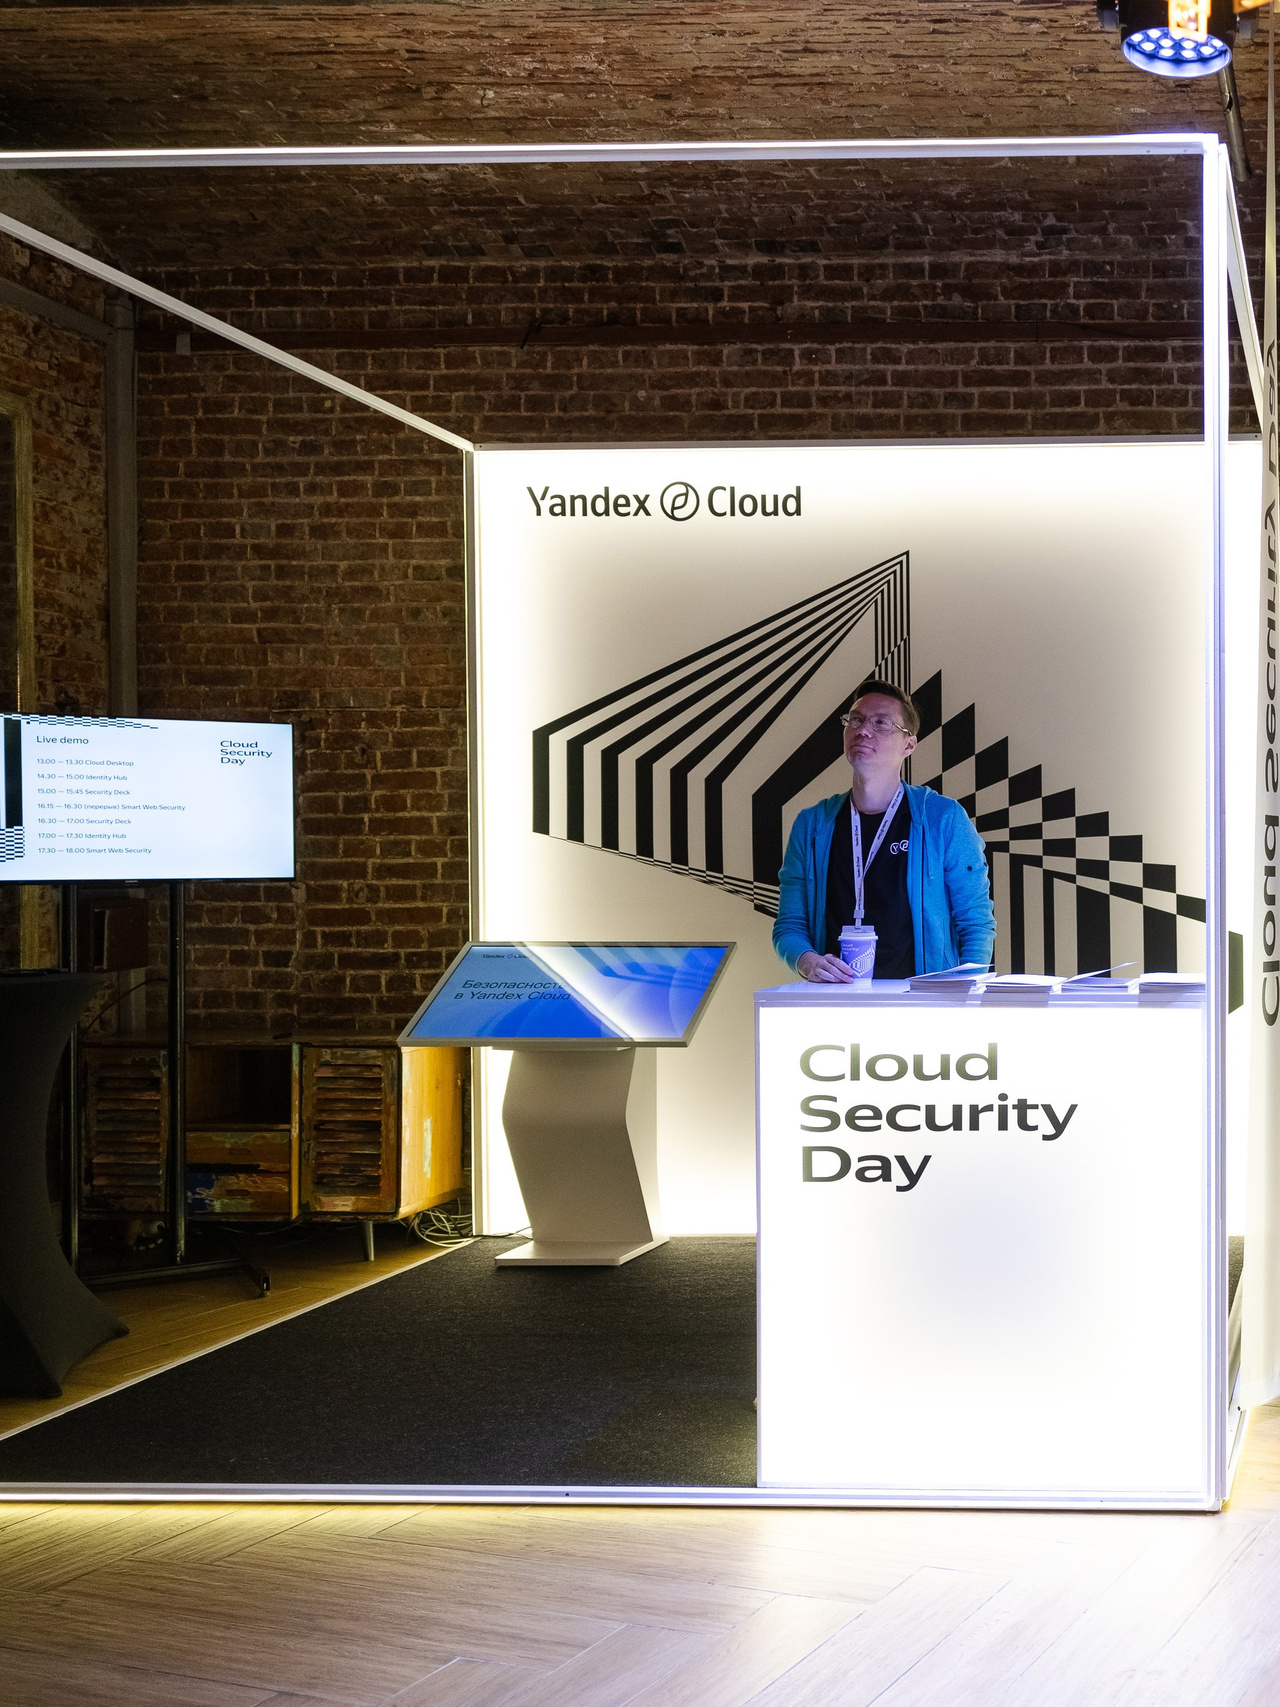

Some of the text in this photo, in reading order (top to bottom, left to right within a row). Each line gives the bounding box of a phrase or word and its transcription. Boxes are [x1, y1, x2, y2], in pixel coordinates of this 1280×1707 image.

[526, 485, 802, 517] Yandex Cloud
[36, 735, 89, 745] Live demo
[220, 740, 258, 748] Cloud
[220, 749, 273, 758] Security
[220, 757, 246, 766] Day
[120, 803, 141, 811] Smart
[158, 804, 186, 812] Security
[124, 847, 152, 855] Security
[462, 980, 567, 989] Безопасность
[454, 991, 572, 1000] в Yandex Cloud
[800, 1043, 998, 1081] Cloud
[800, 1093, 1079, 1141] Security
[802, 1146, 932, 1192] Day
